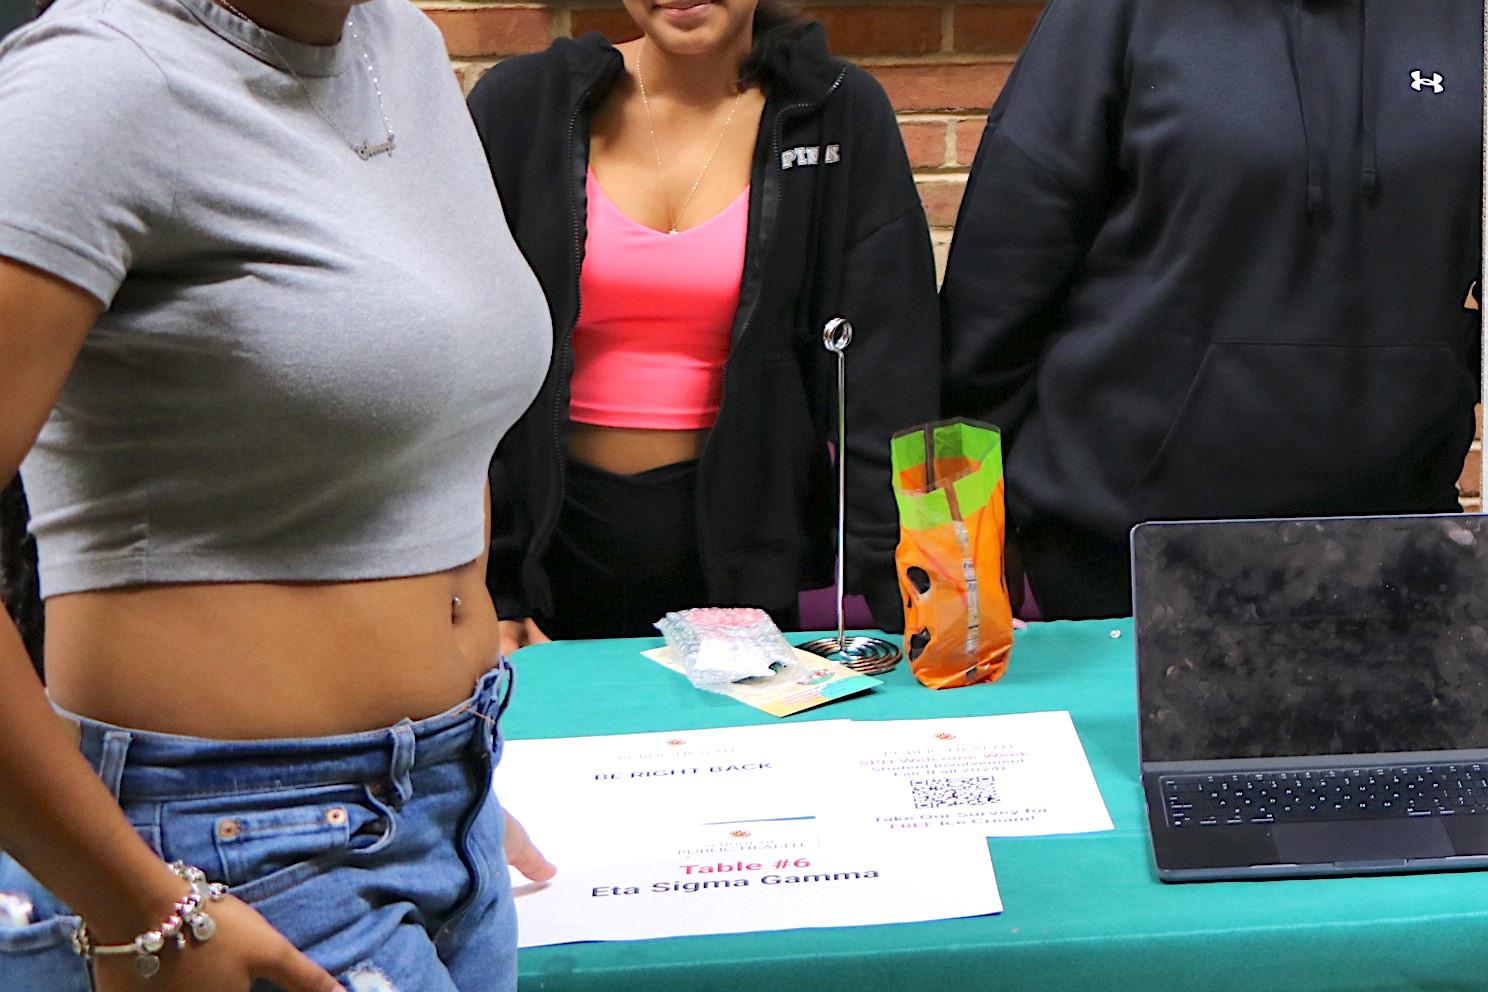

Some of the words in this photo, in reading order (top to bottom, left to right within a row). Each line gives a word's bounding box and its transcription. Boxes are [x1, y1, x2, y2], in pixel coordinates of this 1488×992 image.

[630, 768, 698, 779] RIGHT
[709, 762, 773, 773] BACK
[679, 861, 763, 876] Table
[774, 857, 811, 870] #6
[591, 886, 640, 898] Eta
[652, 878, 750, 894] Sigma
[761, 868, 880, 885] Gamma
